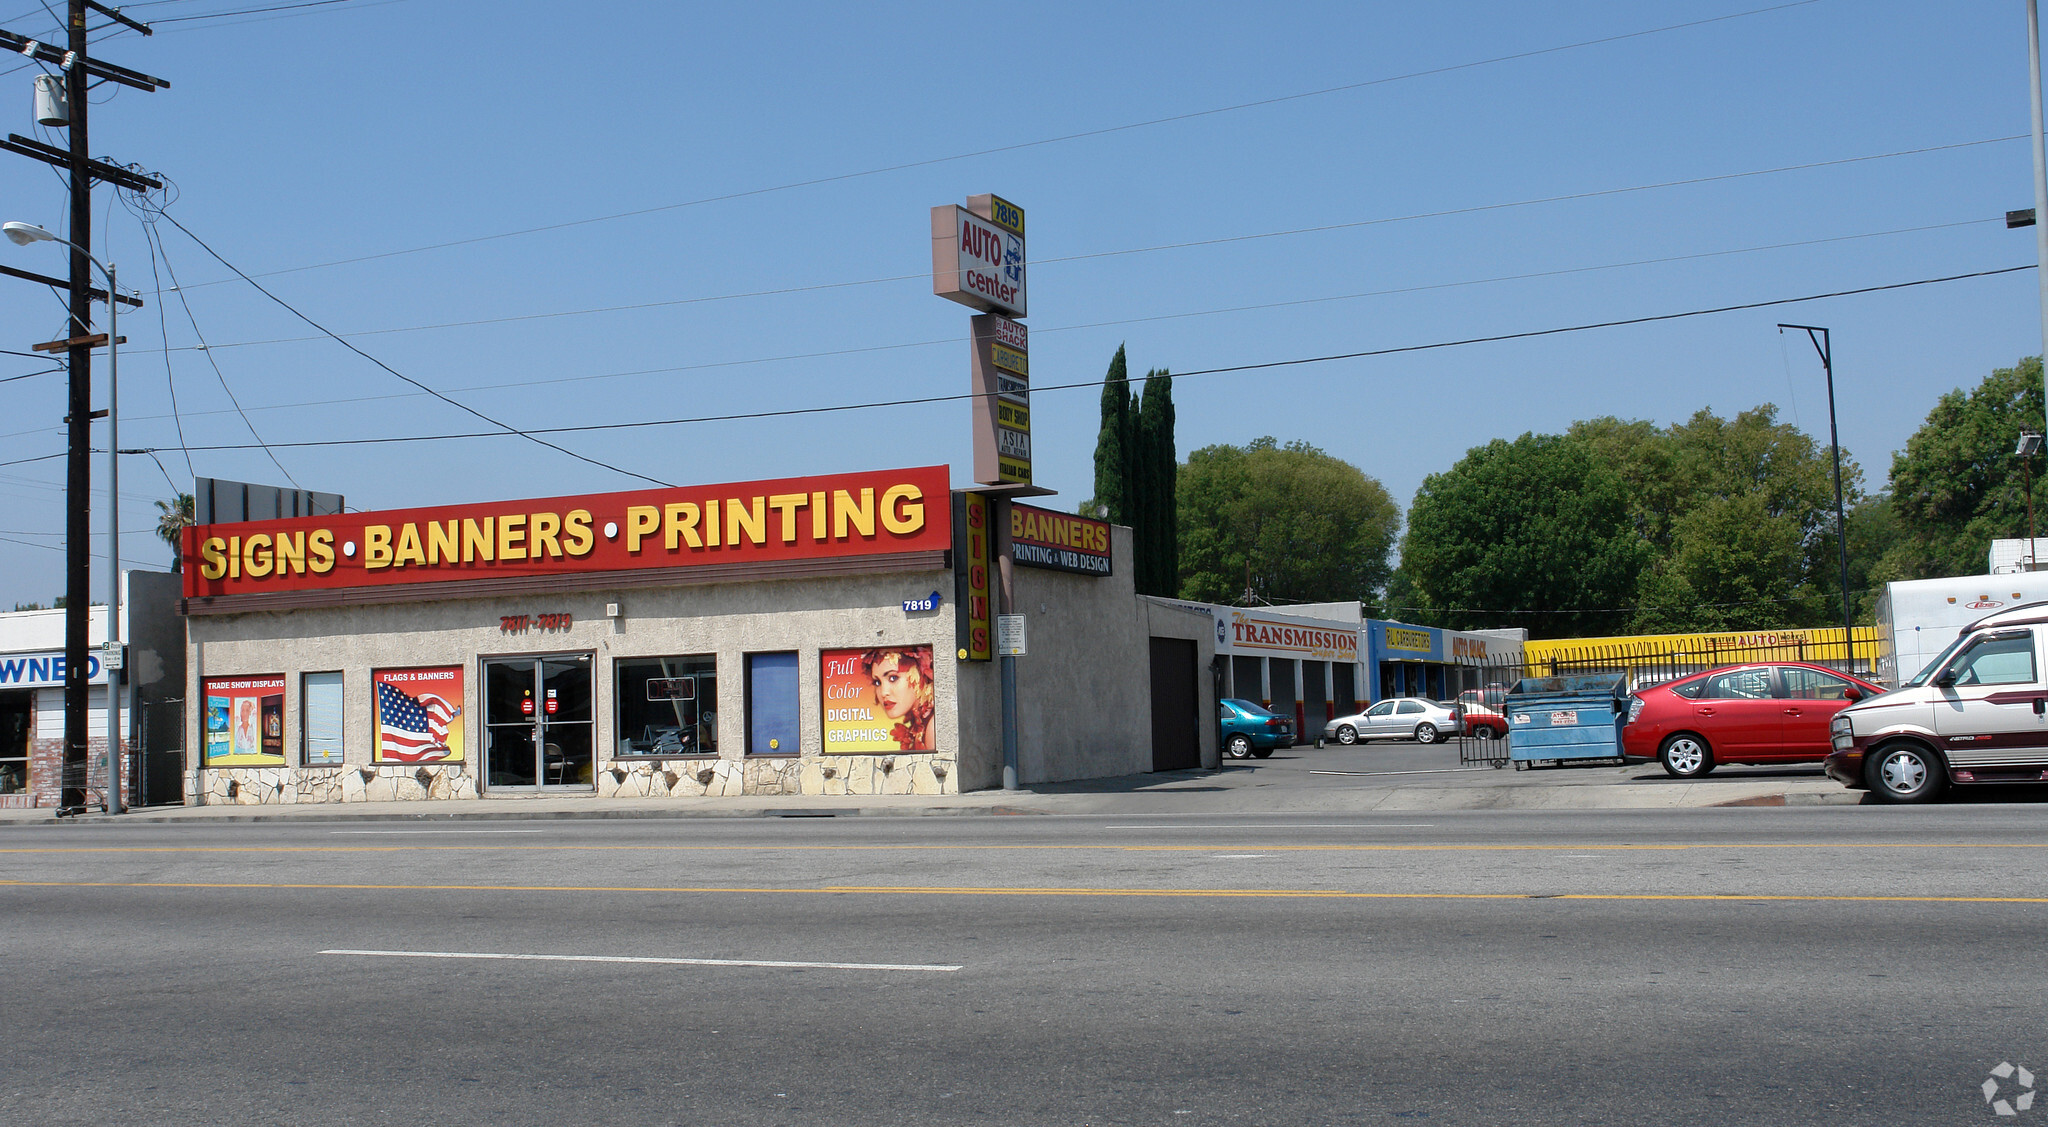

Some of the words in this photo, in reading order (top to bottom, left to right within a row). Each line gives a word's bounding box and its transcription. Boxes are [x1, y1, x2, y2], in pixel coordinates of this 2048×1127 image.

[995, 201, 1019, 228] 7819
[962, 220, 1001, 266] AUTO
[967, 270, 1017, 304] center
[996, 329, 1026, 348] SHACK
[1003, 321, 1026, 337] AUTO
[998, 404, 1013, 422] BODY
[1014, 409, 1028, 426] SHOP
[1003, 430, 1025, 448] ASIA
[201, 529, 336, 580] SIGNS
[365, 509, 594, 569] BANNERS
[627, 484, 924, 552] PRINTING
[1012, 510, 1108, 552] BANNERS
[1060, 553, 1079, 568] WEB
[1081, 555, 1109, 572] DESIGN
[969, 504, 987, 652] SIGNS
[904, 600, 932, 611] 7819
[499, 613, 571, 631] 7811-7819
[1232, 612, 1249, 625] The
[1232, 622, 1357, 651] TRANSMISSION
[1386, 628, 1395, 646] RL
[1738, 634, 1777, 646] AUTO
[1780, 633, 1805, 641] WORKS
[1311, 644, 1336, 659] Super
[1338, 645, 1357, 661] Shop
[1453, 636, 1468, 657] AUTO
[383, 673, 408, 681] FLAGS
[417, 672, 455, 680] BANNERS
[826, 657, 857, 679] Full
[649, 679, 693, 699] OPEN
[827, 682, 862, 699] Color
[827, 708, 874, 721] DIGITAL
[828, 728, 887, 742] GRAPHICS
